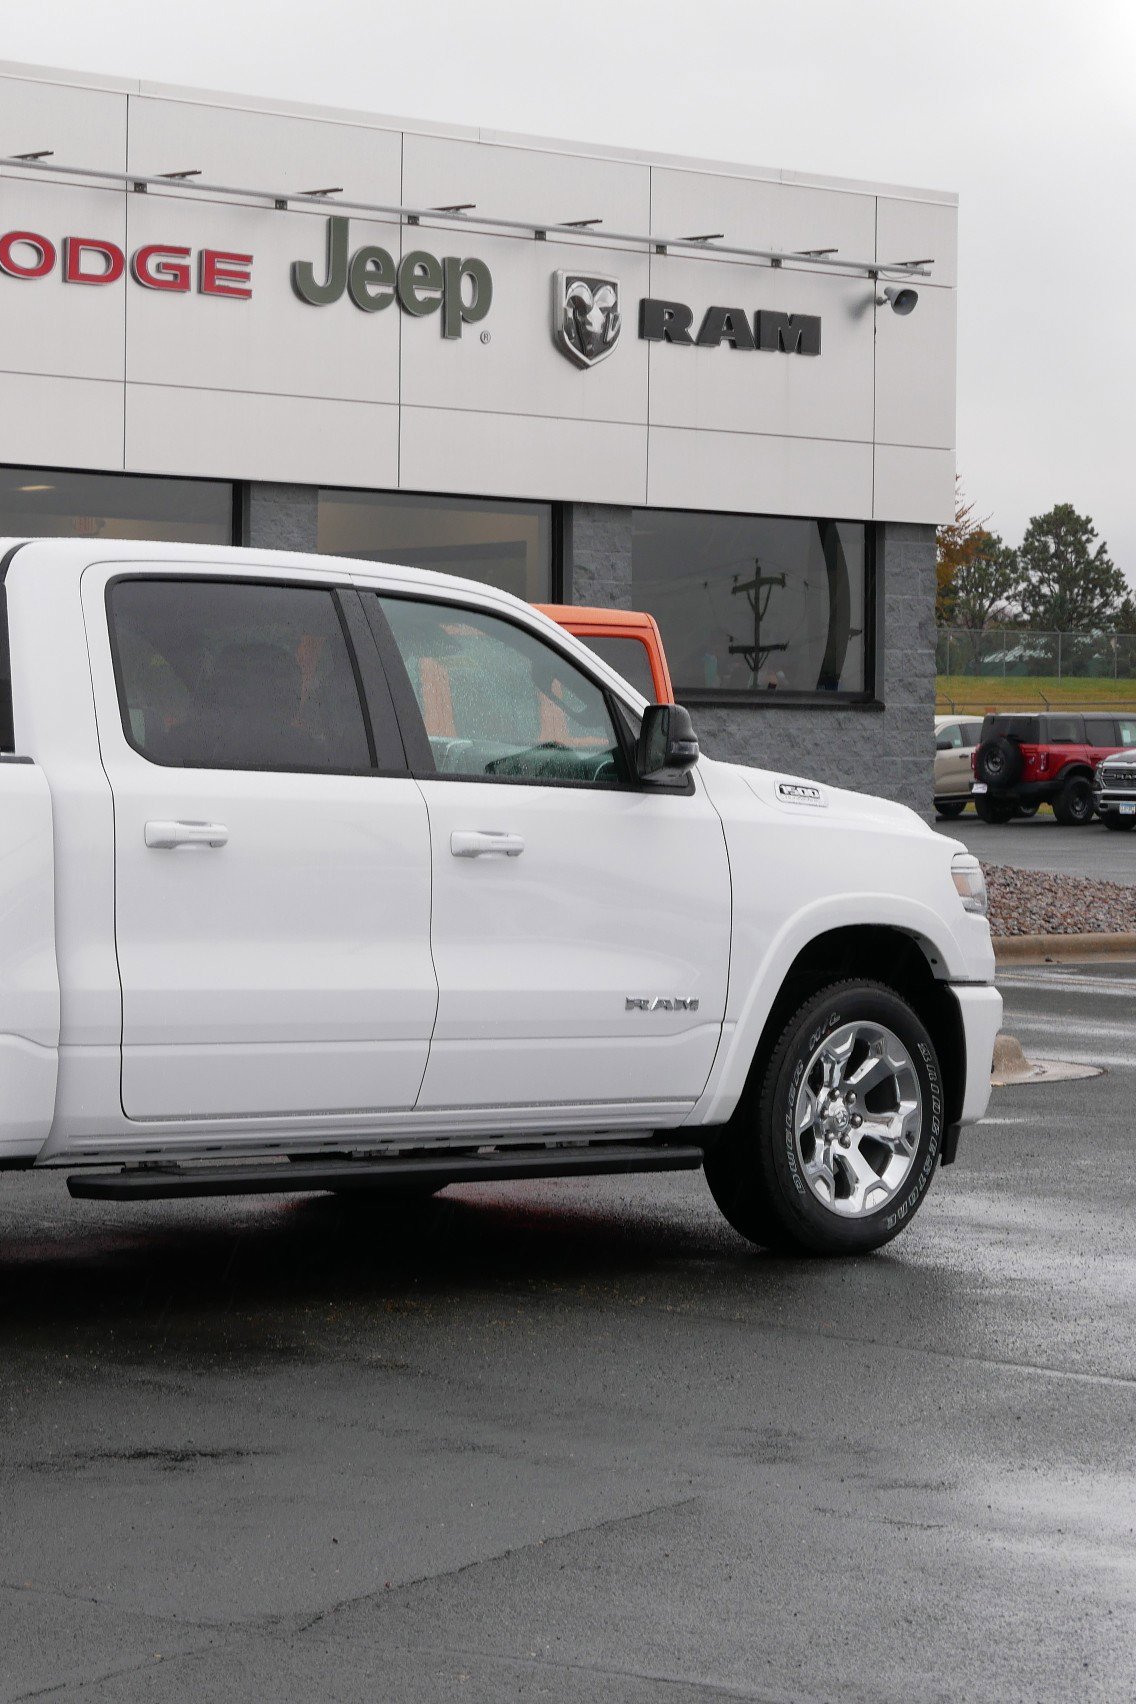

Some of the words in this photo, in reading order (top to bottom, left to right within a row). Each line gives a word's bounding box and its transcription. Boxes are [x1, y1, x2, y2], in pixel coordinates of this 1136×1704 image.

[291, 216, 494, 341] Jeep
[637, 298, 823, 357] RAM
[625, 996, 700, 1012] RAM
